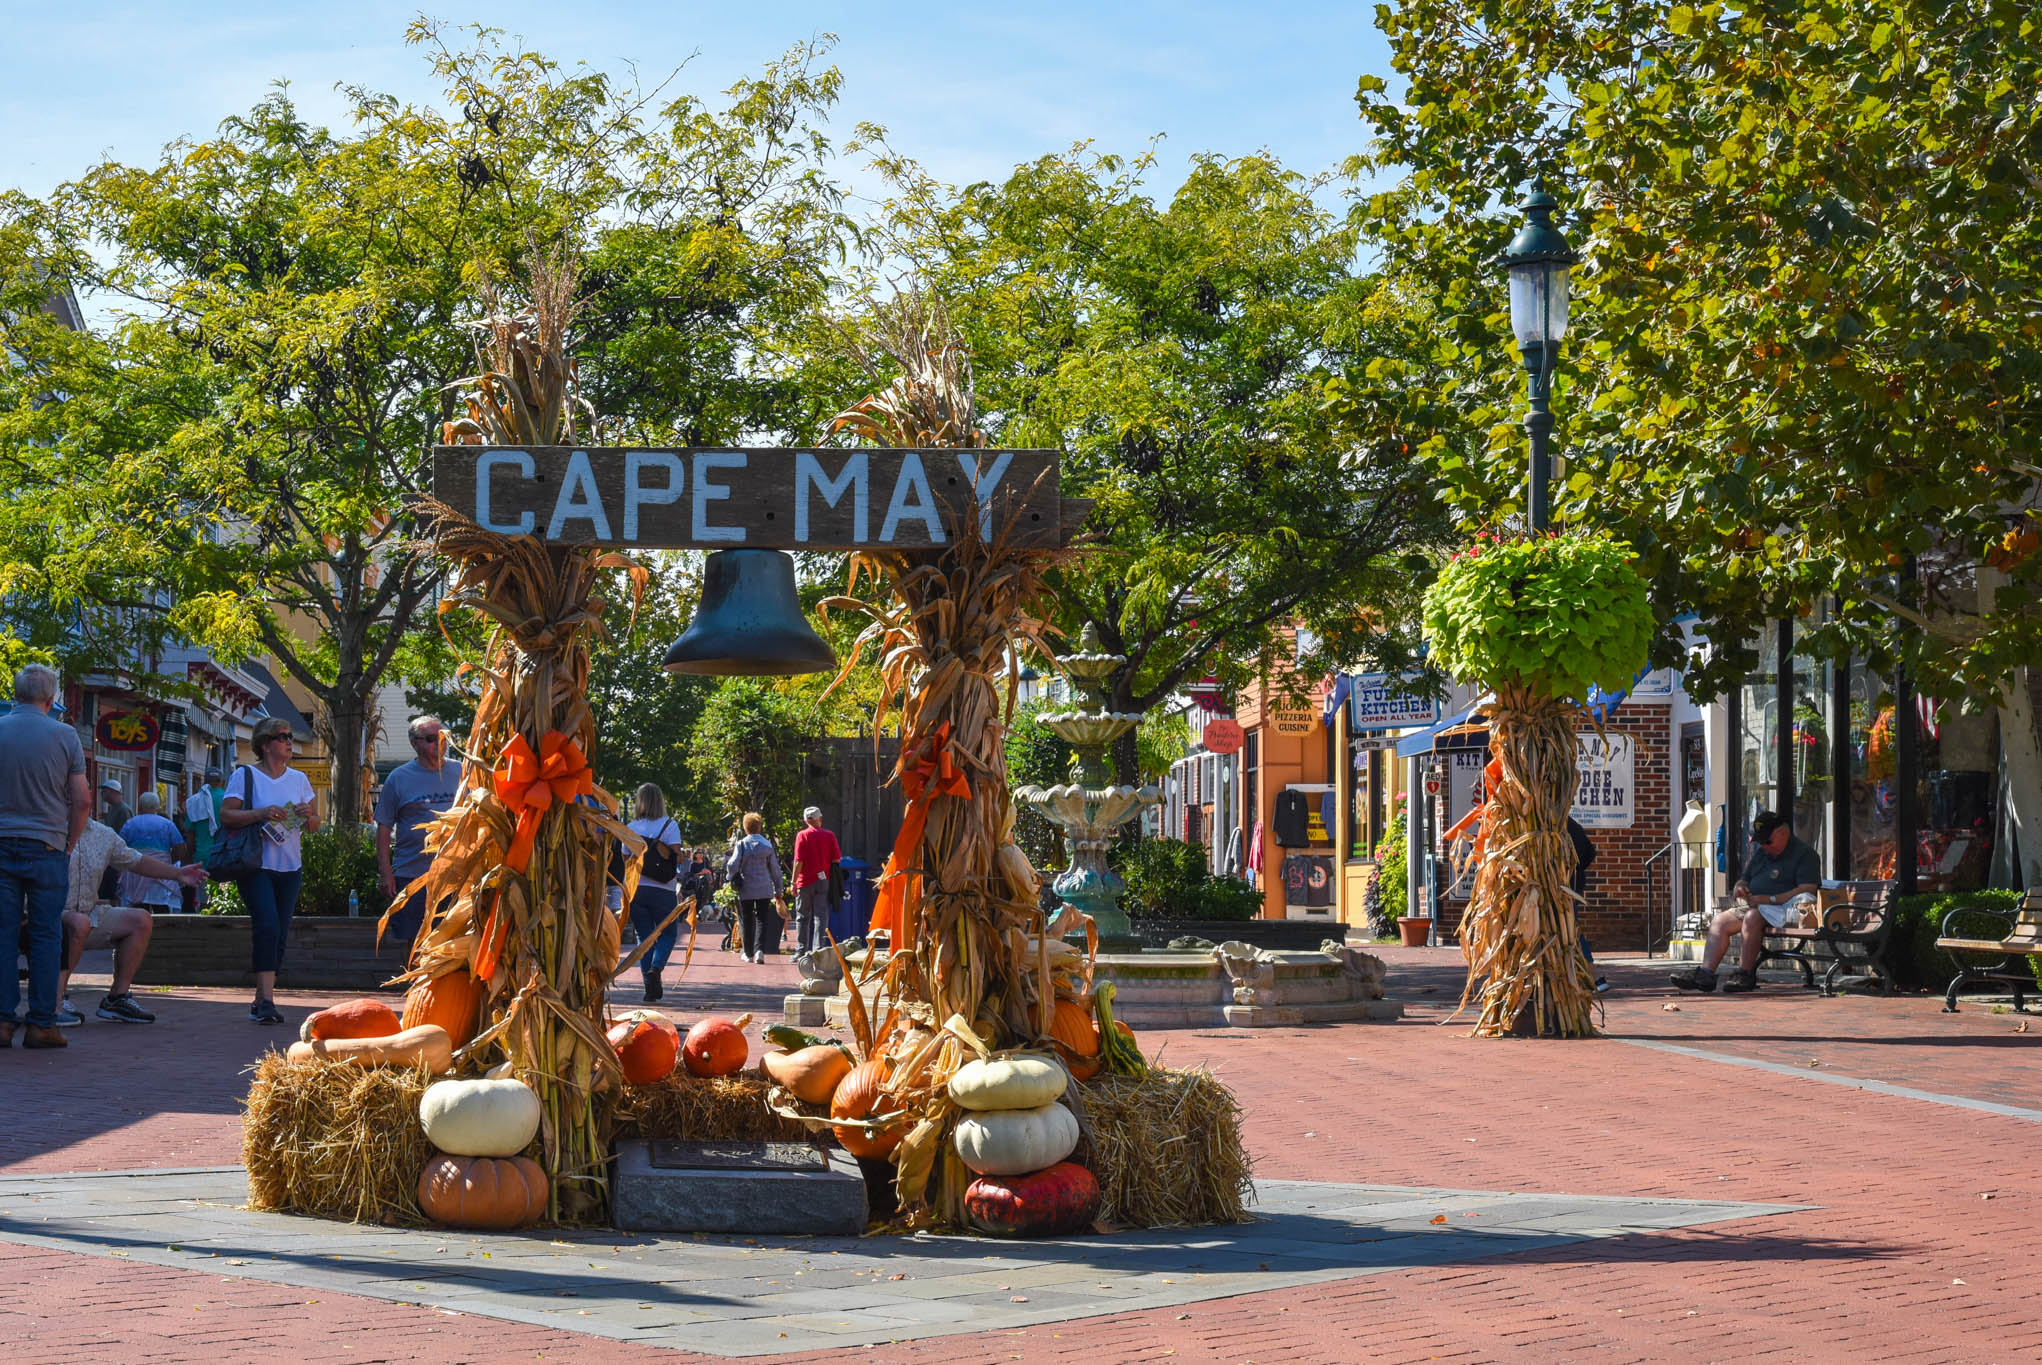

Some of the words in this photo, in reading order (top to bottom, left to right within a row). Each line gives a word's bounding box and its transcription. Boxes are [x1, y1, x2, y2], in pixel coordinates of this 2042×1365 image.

[475, 450, 748, 542] CAPE
[795, 453, 1014, 544] MAY
[1361, 701, 1431, 715] KITCHEN
[1275, 713, 1312, 721] PIZZERIA
[1426, 772, 1440, 780] AED
[1582, 770, 1612, 787] DGE
[1579, 788, 1624, 806] CHEN
